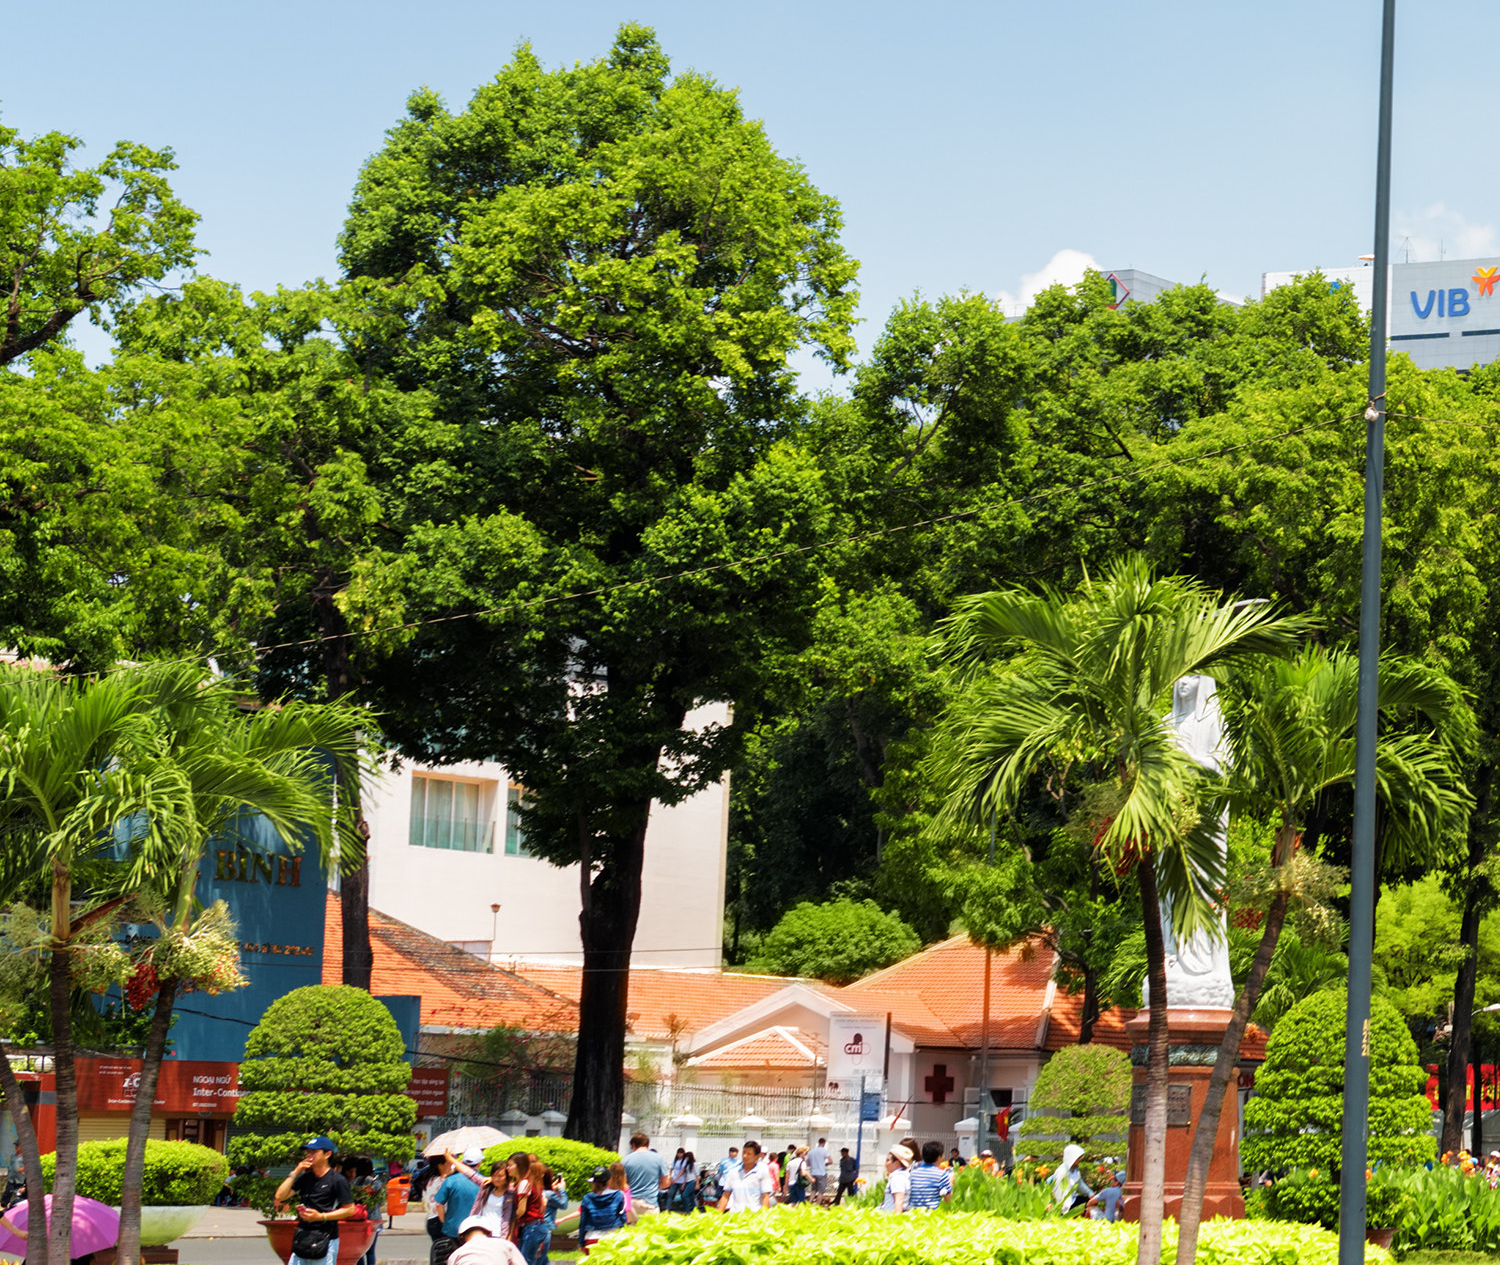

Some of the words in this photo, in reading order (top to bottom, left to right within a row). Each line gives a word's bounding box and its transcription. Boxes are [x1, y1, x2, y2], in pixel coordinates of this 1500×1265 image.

[1410, 288, 1471, 319] VIB
[214, 841, 302, 887] BÌNH
[846, 1042, 861, 1053] cmi
